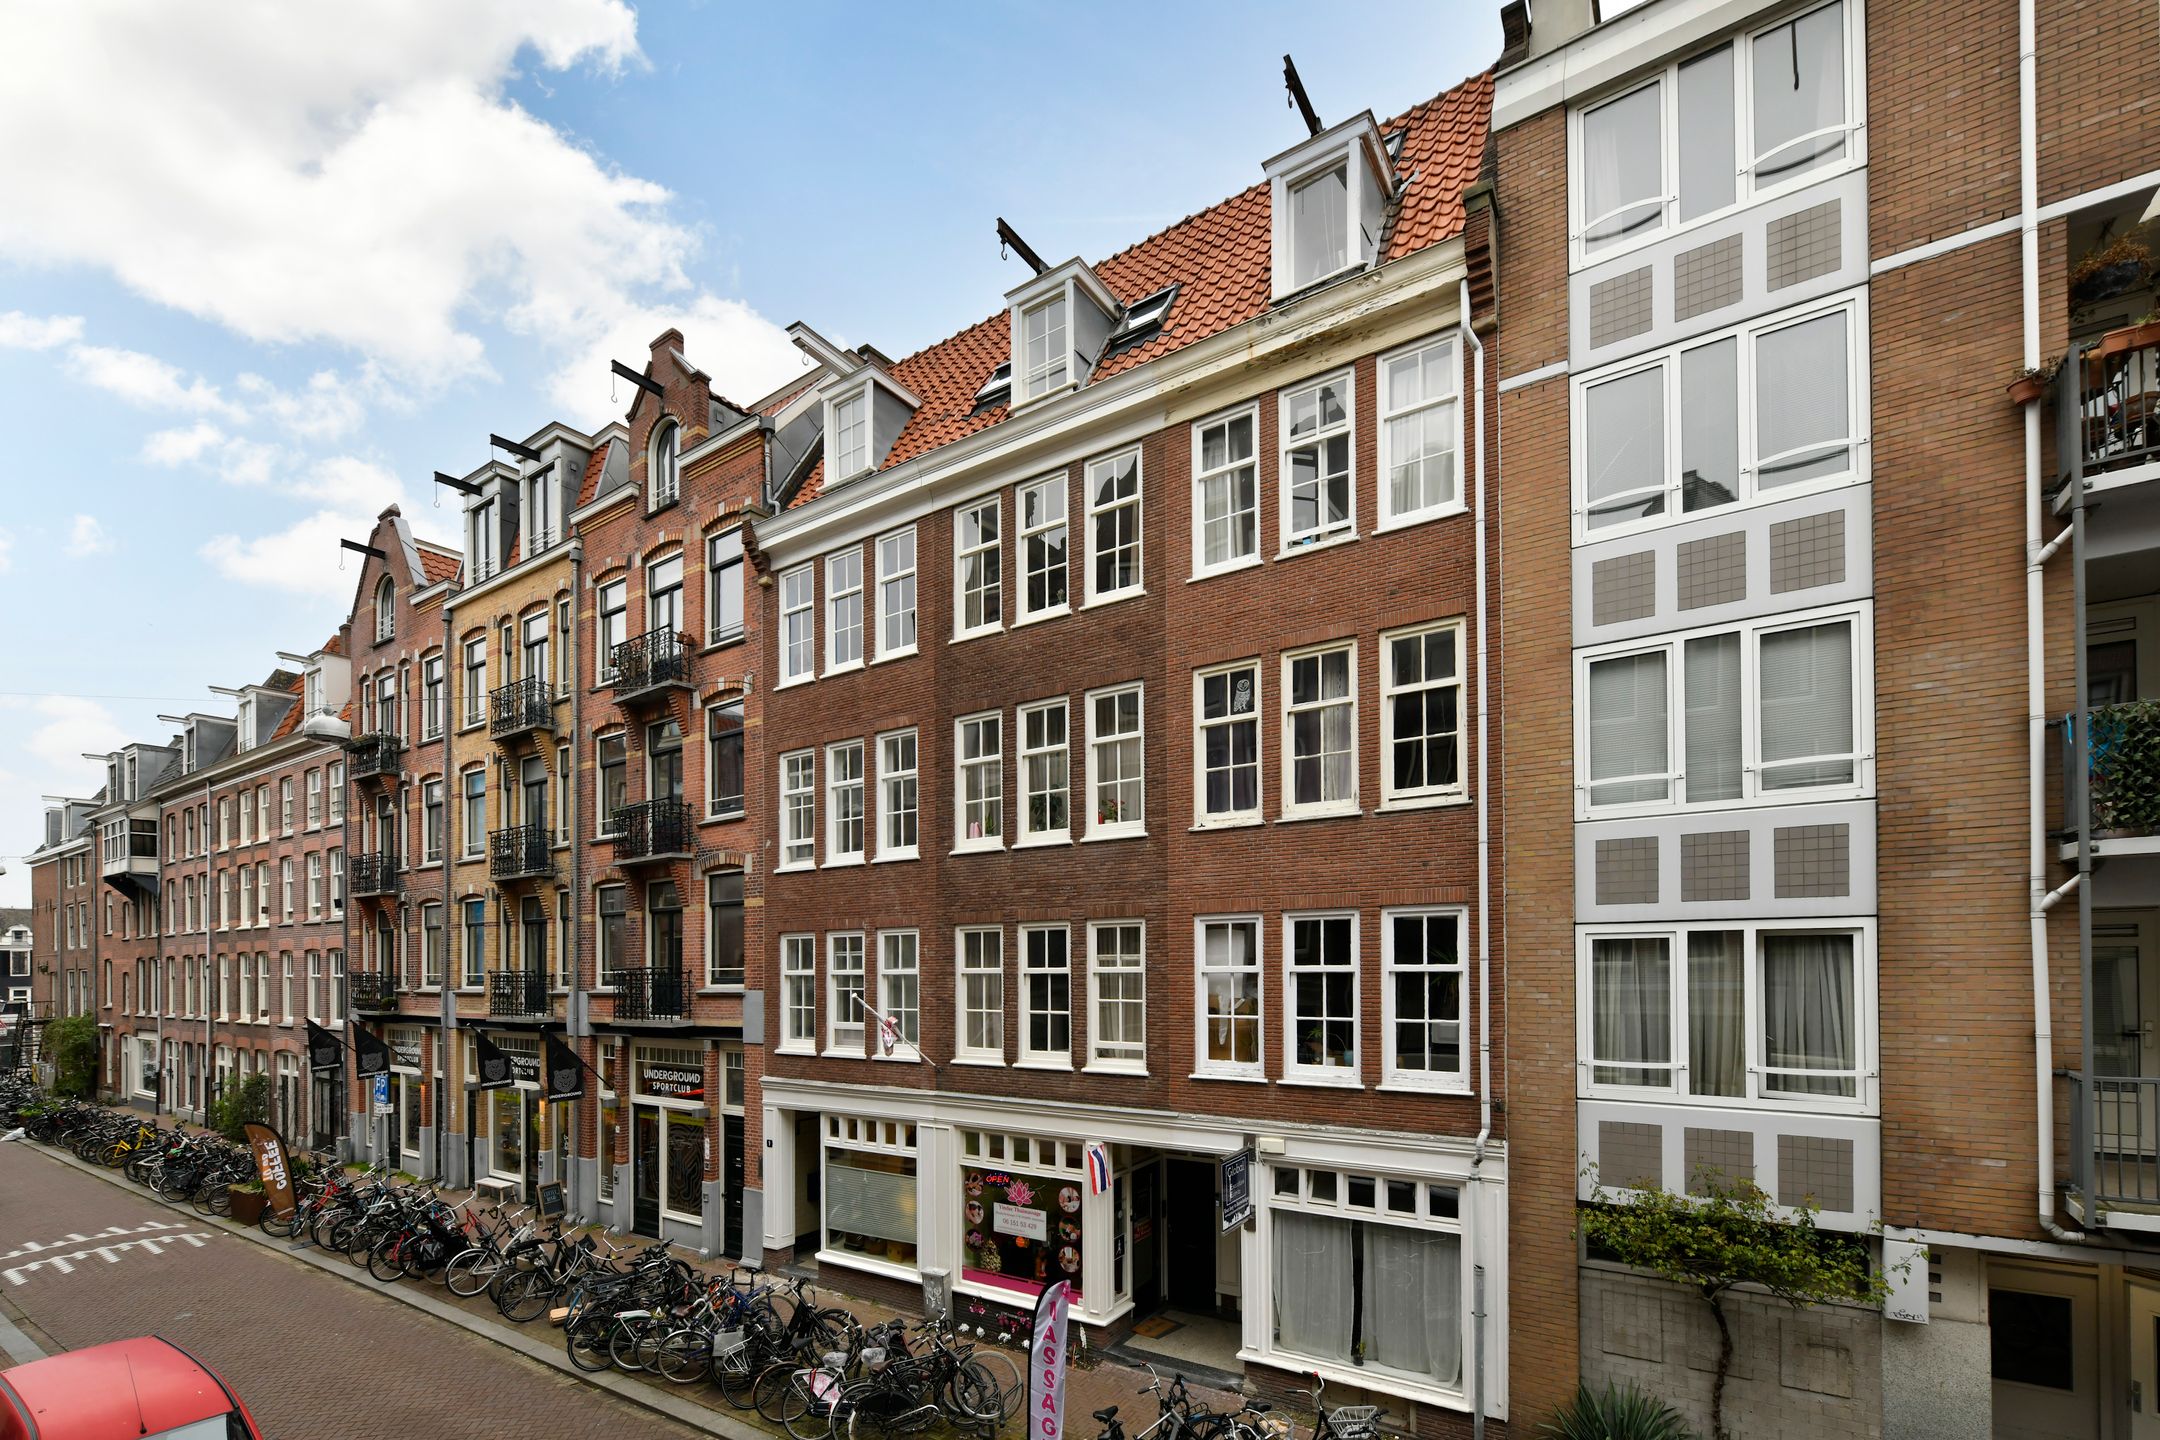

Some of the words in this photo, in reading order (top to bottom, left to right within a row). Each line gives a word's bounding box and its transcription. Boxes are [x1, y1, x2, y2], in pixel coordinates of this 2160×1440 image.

[643, 1068, 701, 1084] UNDERGROUND
[652, 1081, 691, 1093] SPORTCLUB
[1227, 1160, 1245, 1177] Global
[985, 1175, 1010, 1183] OPEN
[1041, 1301, 1058, 1440] ASSAG
